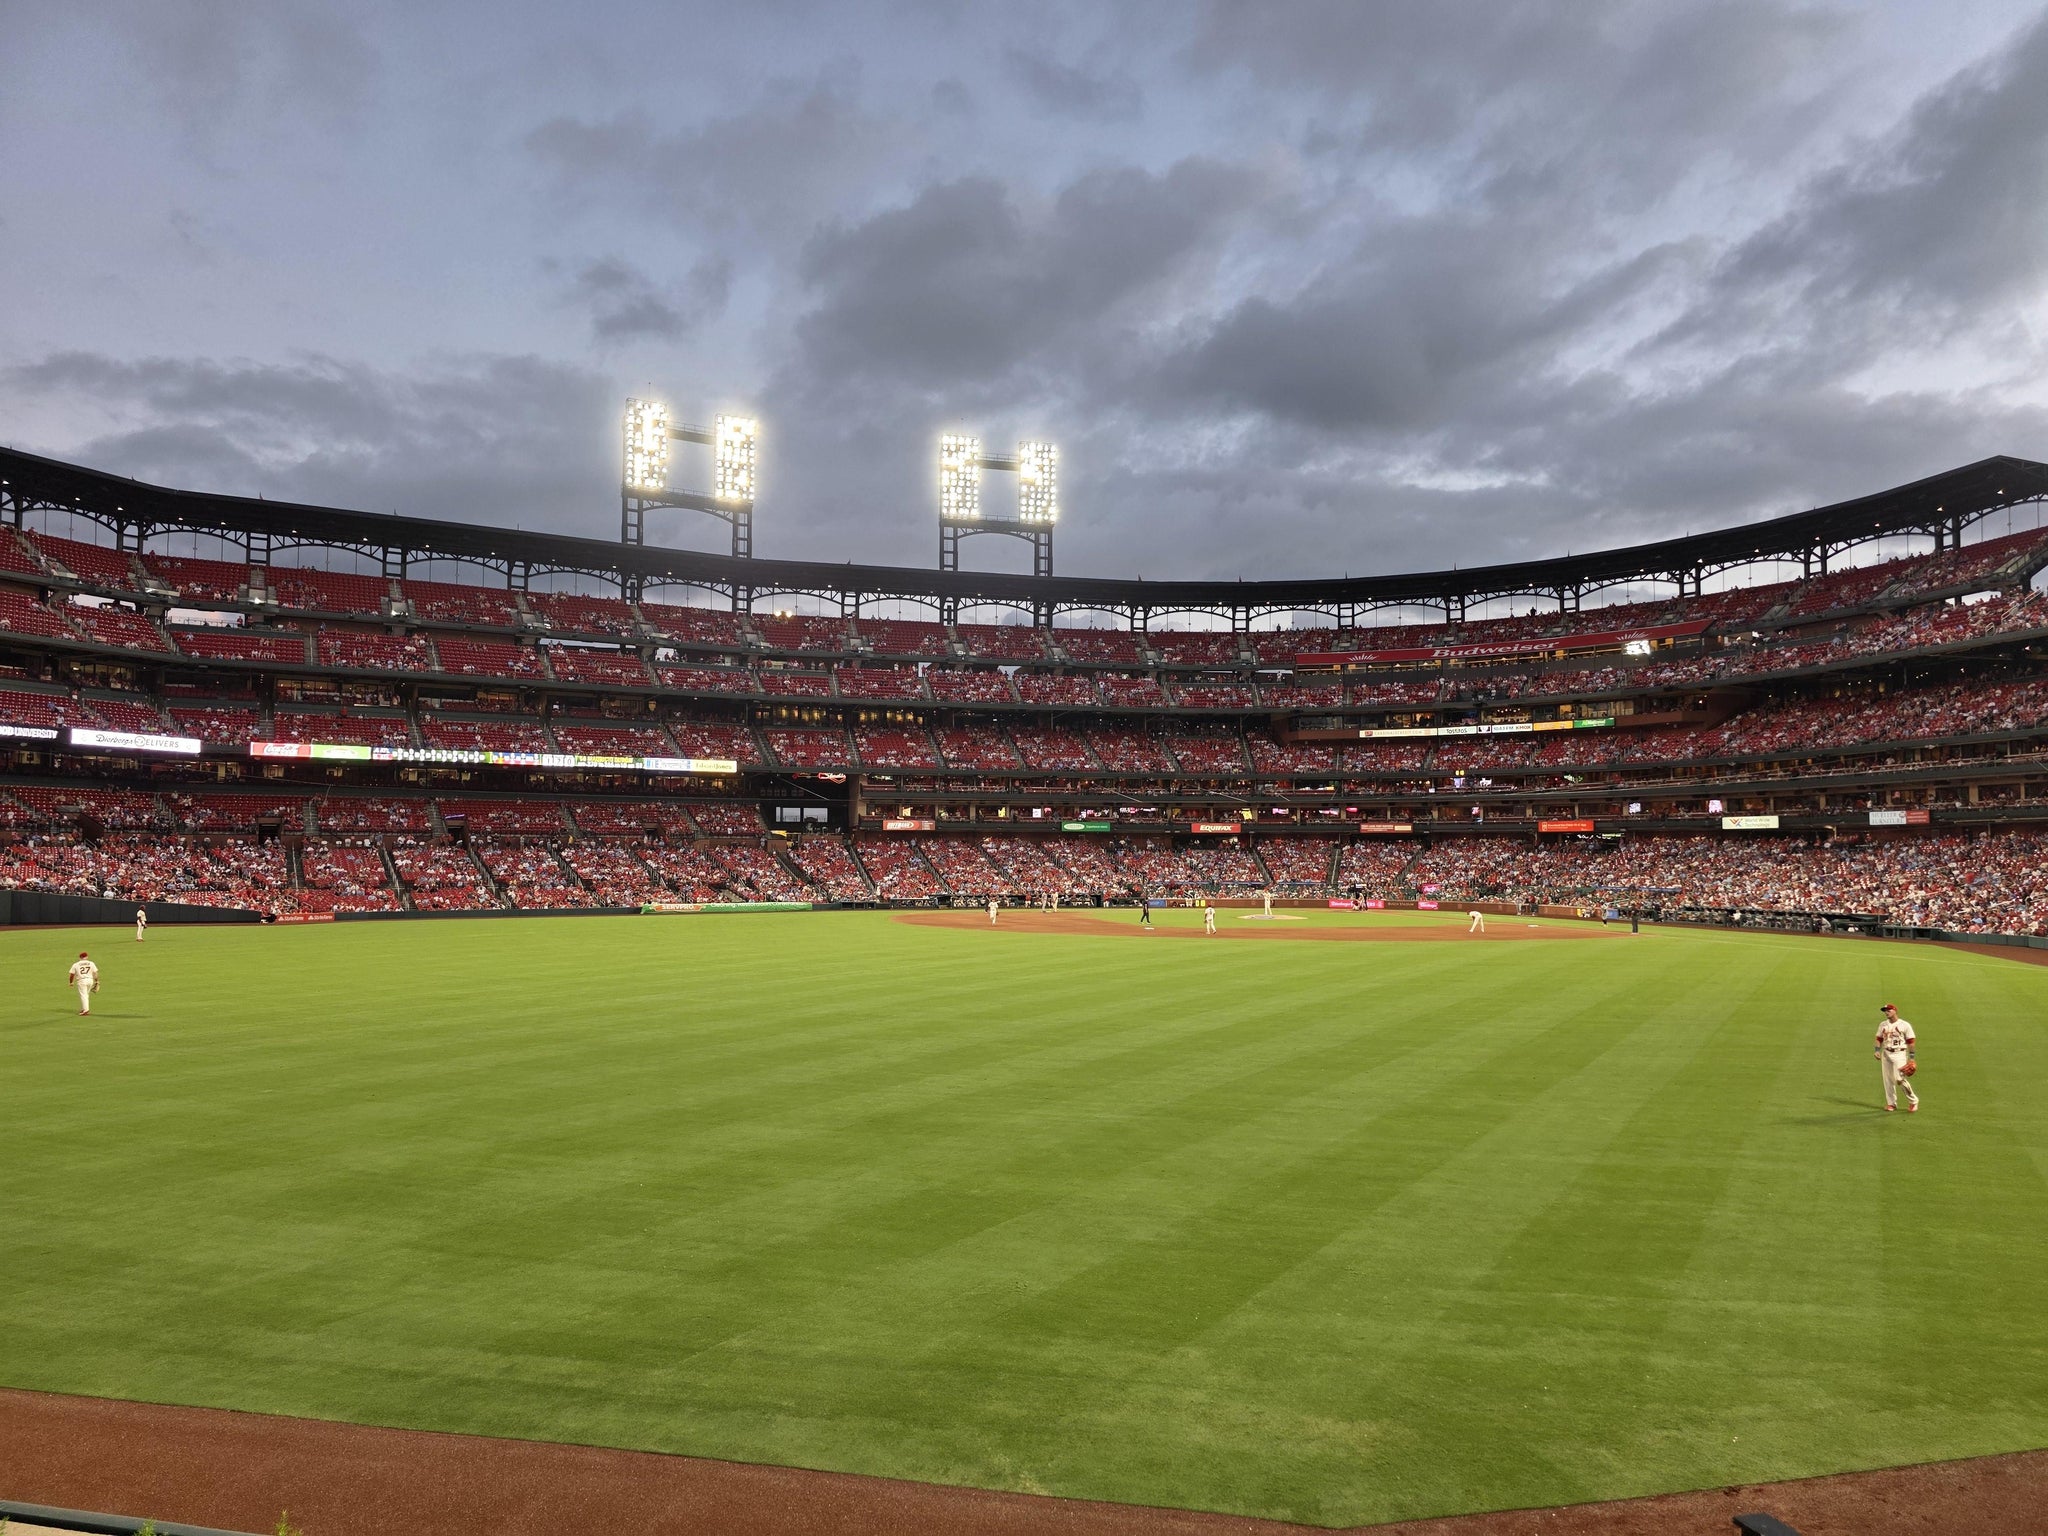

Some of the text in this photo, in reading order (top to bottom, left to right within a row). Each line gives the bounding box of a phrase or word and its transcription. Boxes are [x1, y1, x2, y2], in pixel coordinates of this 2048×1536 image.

[1431, 642, 1560, 657] Budweiser
[15, 727, 58, 739] UNIVERSITY
[96, 734, 133, 745] Dierbergs
[80, 966, 90, 975] 27
